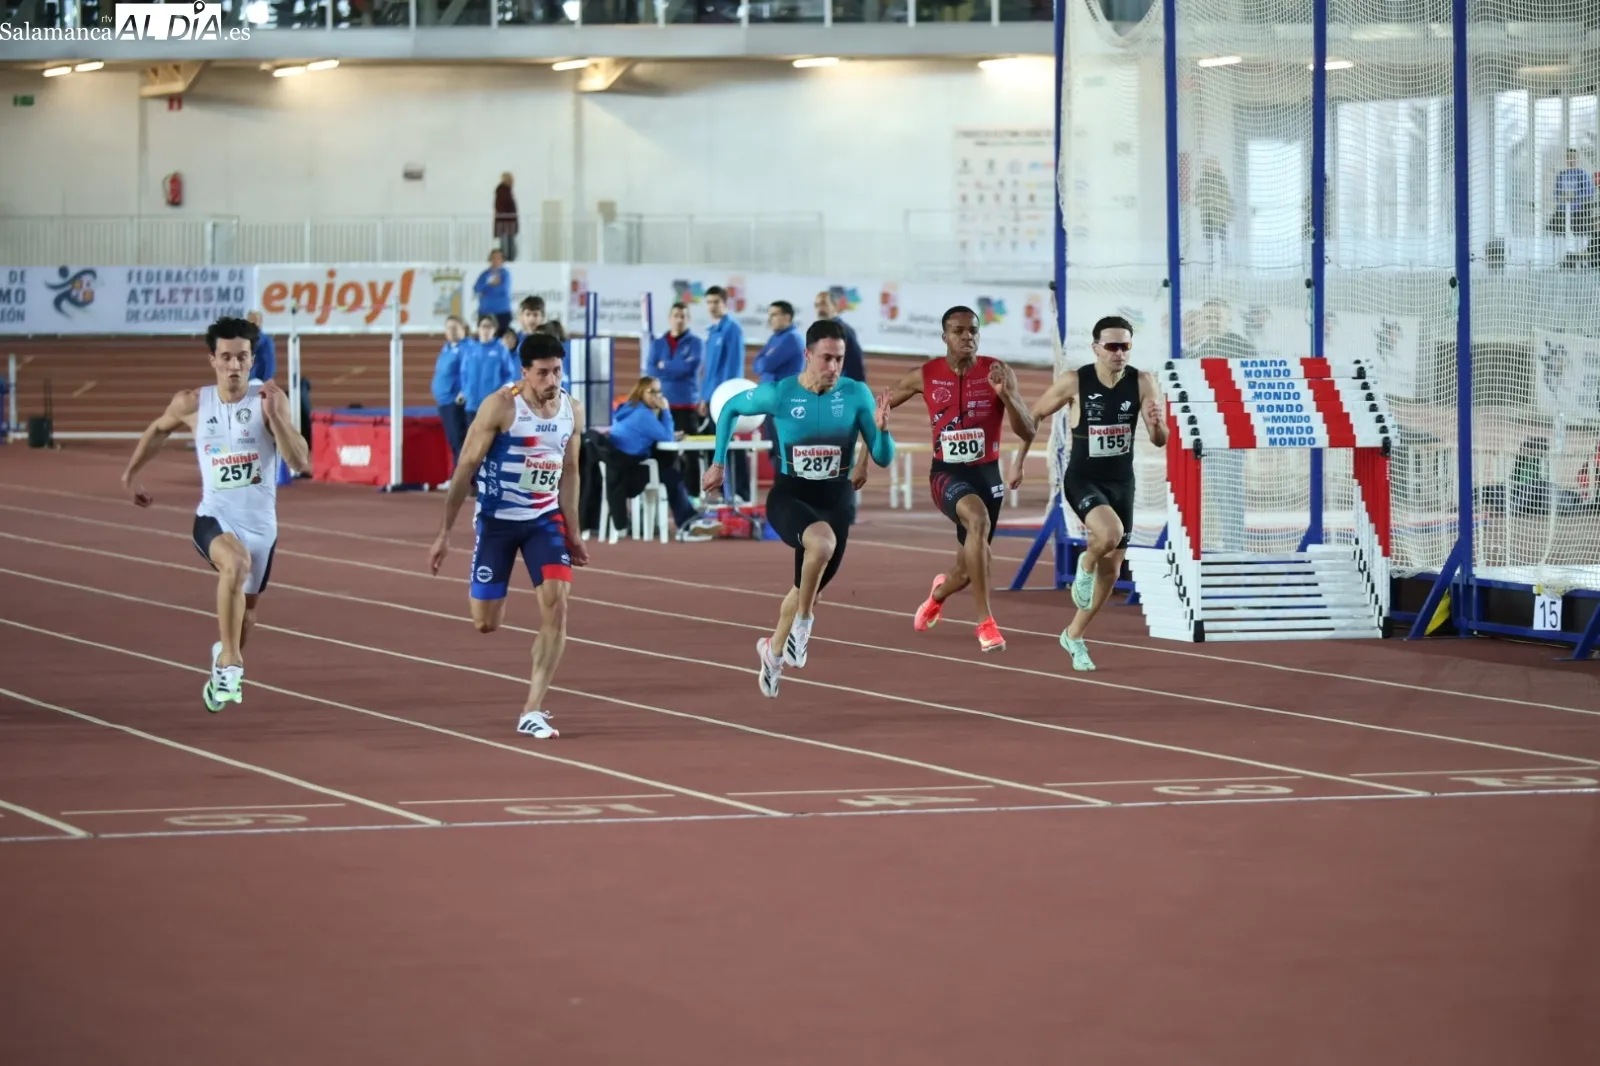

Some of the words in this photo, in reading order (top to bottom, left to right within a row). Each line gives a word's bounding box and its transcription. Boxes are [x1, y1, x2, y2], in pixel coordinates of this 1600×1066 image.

[9, 269, 26, 283] DE
[126, 268, 219, 284] FEDERACIÓN
[228, 269, 244, 282] DE
[126, 287, 245, 304] ATLETISMO
[261, 268, 416, 327] enjoy!
[126, 309, 140, 323] DE
[142, 308, 199, 323] CASTILLA
[1244, 368, 1291, 378] MONDO
[1254, 391, 1301, 400] MONDO
[1256, 404, 1304, 413] MONDO
[1271, 415, 1311, 424] MONDO
[535, 423, 558, 433] aula
[1090, 425, 1131, 436] bedunia
[1266, 426, 1314, 435] MONDO
[941, 430, 985, 442] bedunia
[1097, 435, 1125, 450] 155
[1269, 437, 1316, 446] MONDO
[794, 446, 841, 458] bedunia
[949, 440, 979, 456] 280
[212, 452, 260, 467] bedunia
[802, 457, 833, 472] 287
[220, 462, 253, 483] 257
[531, 470, 556, 486] 156
[1540, 600, 1559, 629] 15
